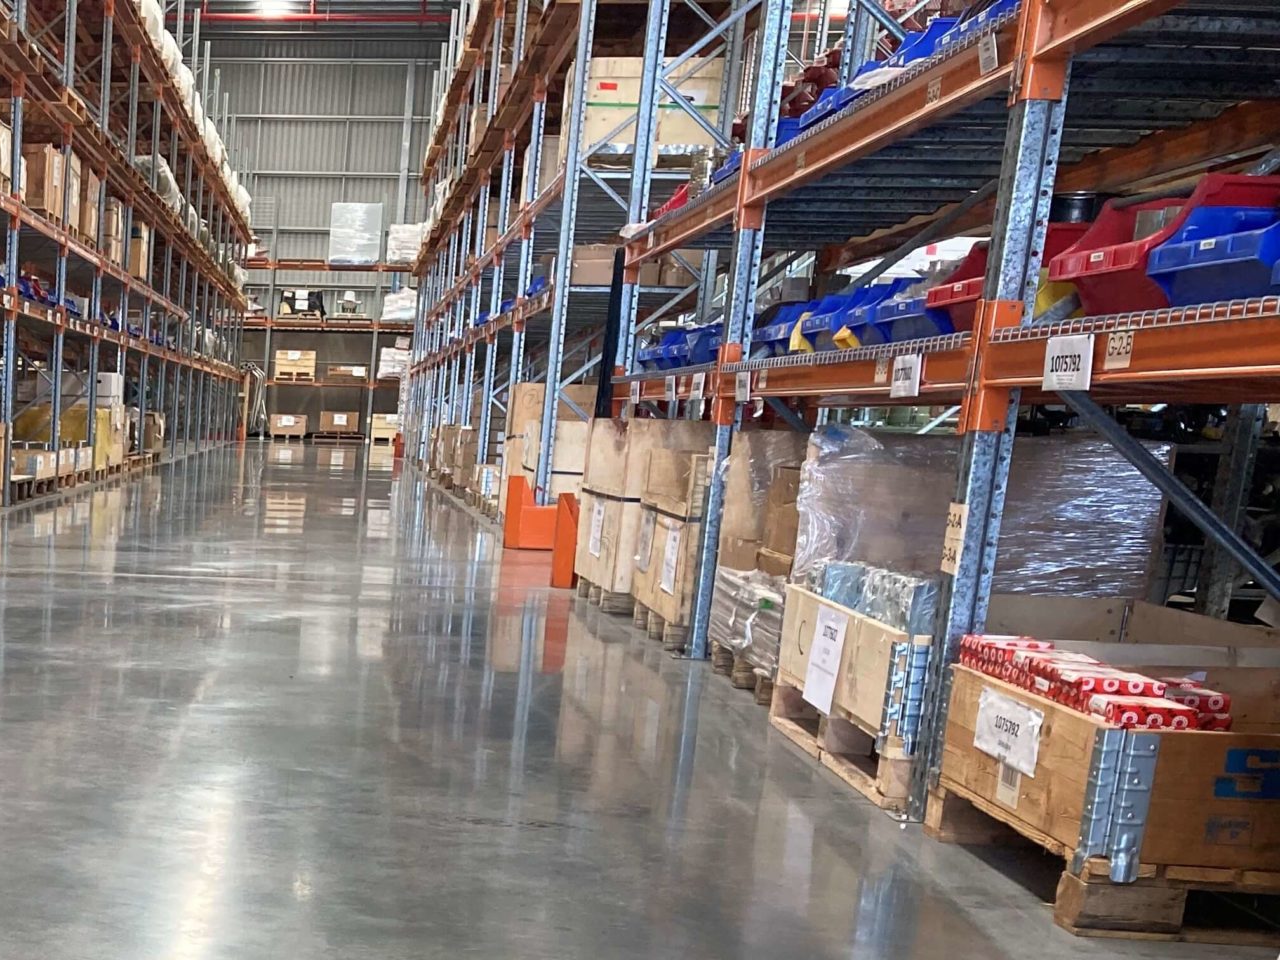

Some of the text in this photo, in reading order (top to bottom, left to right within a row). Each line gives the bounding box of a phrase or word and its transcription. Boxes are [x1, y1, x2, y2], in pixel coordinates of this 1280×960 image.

[1107, 335, 1132, 357] G-2-B
[1049, 354, 1081, 373] 1075792
[994, 714, 1020, 738] 1075792
